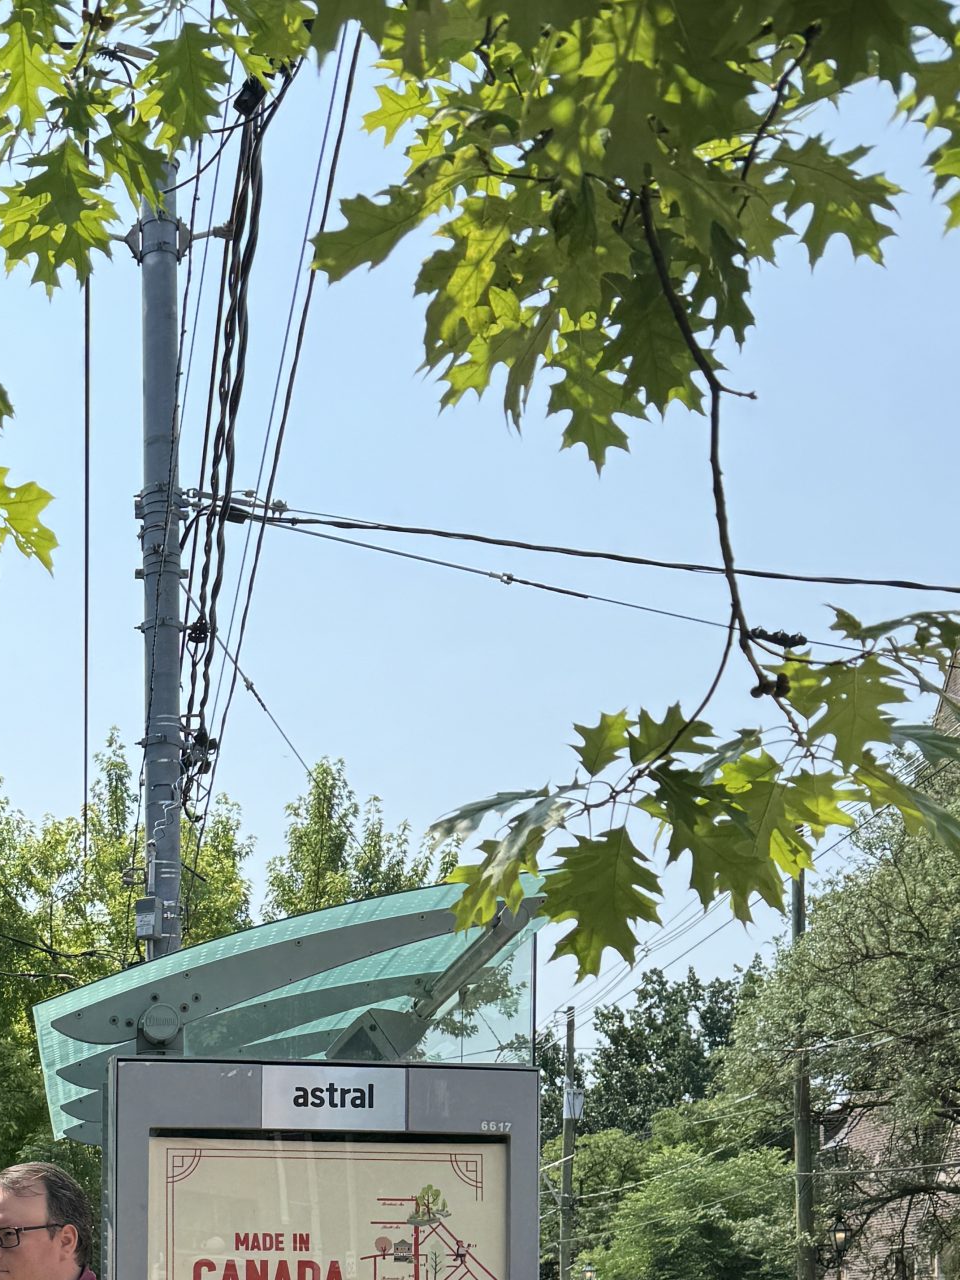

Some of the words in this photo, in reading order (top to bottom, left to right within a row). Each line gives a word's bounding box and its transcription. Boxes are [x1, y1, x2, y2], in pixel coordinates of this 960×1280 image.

[292, 1083, 375, 1109] astral
[480, 1121, 512, 1132] 6617
[234, 1232, 285, 1251] MADE
[292, 1233, 310, 1251] IN
